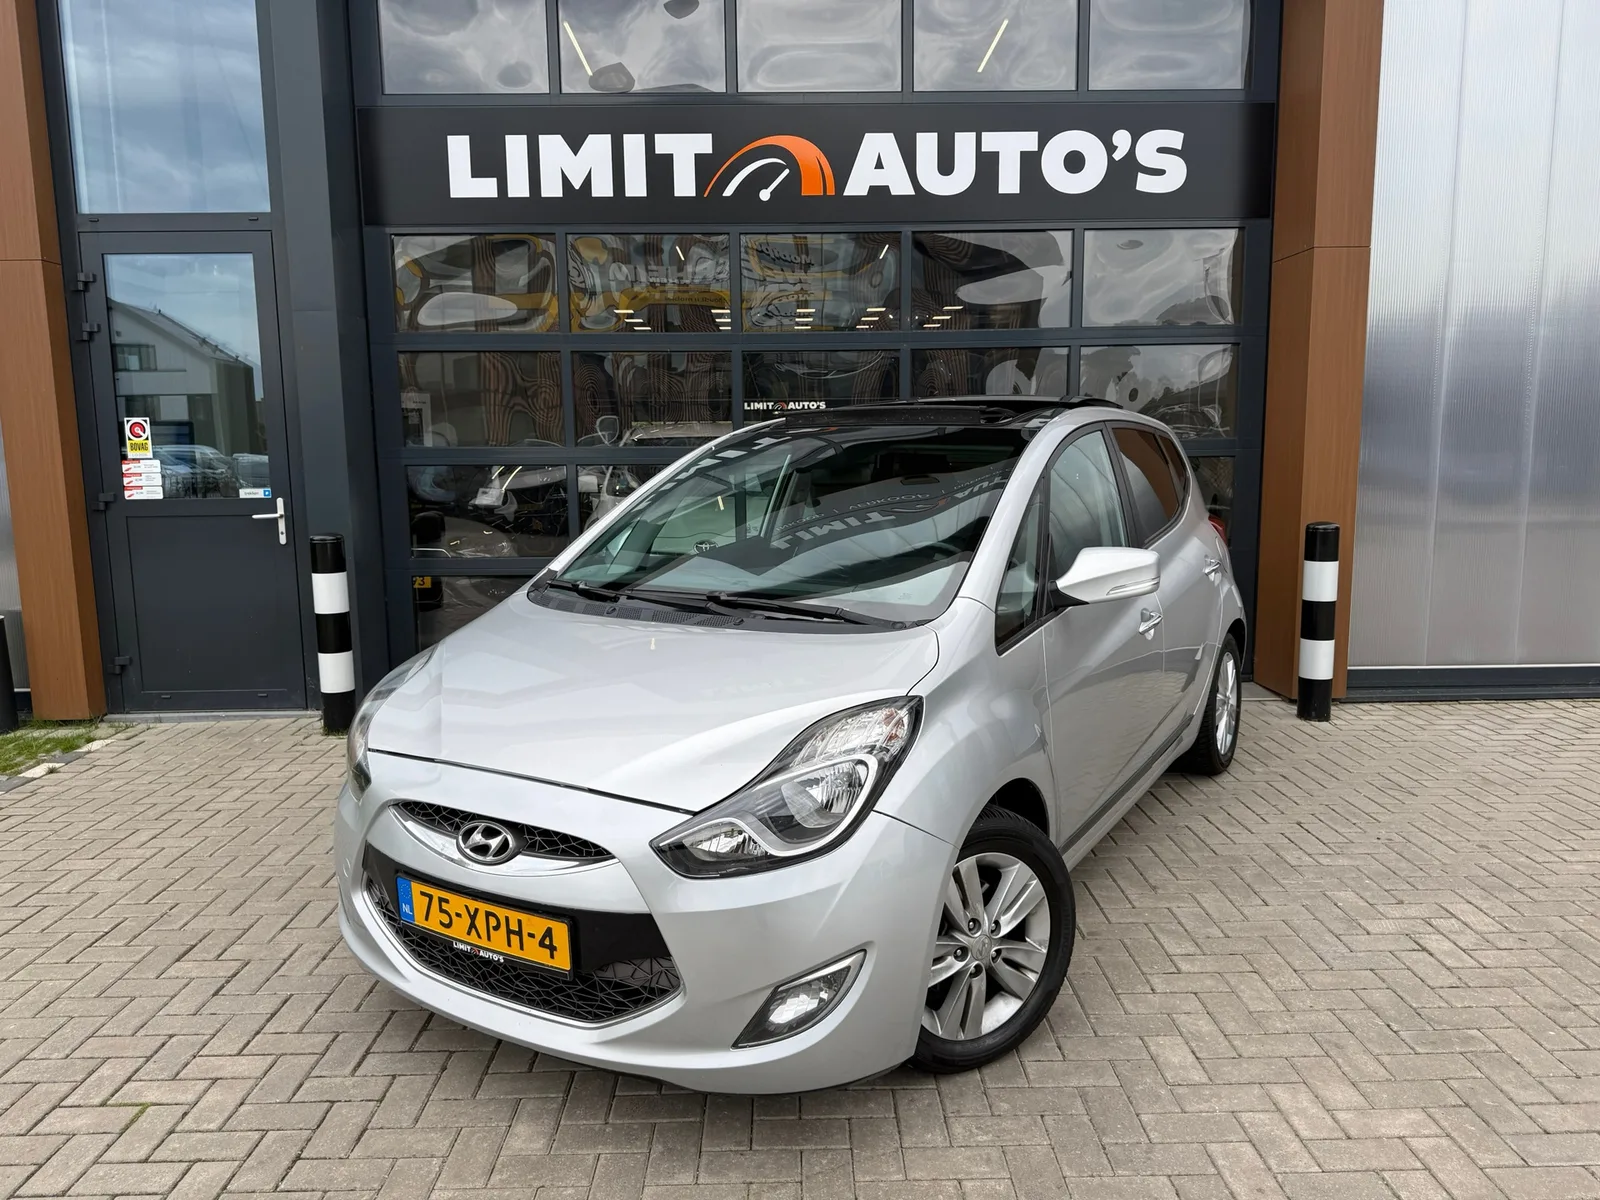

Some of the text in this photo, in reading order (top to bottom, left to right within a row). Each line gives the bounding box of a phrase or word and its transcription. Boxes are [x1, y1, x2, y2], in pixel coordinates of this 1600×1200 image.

[446, 128, 1188, 199] LIMIT AUTO'S
[744, 401, 826, 410] LIMIT AUTO'S
[130, 442, 149, 451] BOVAG
[402, 903, 413, 915] NL
[419, 890, 558, 960] 75-XPH-4
[453, 941, 504, 963] LIMIT AUTO'S
